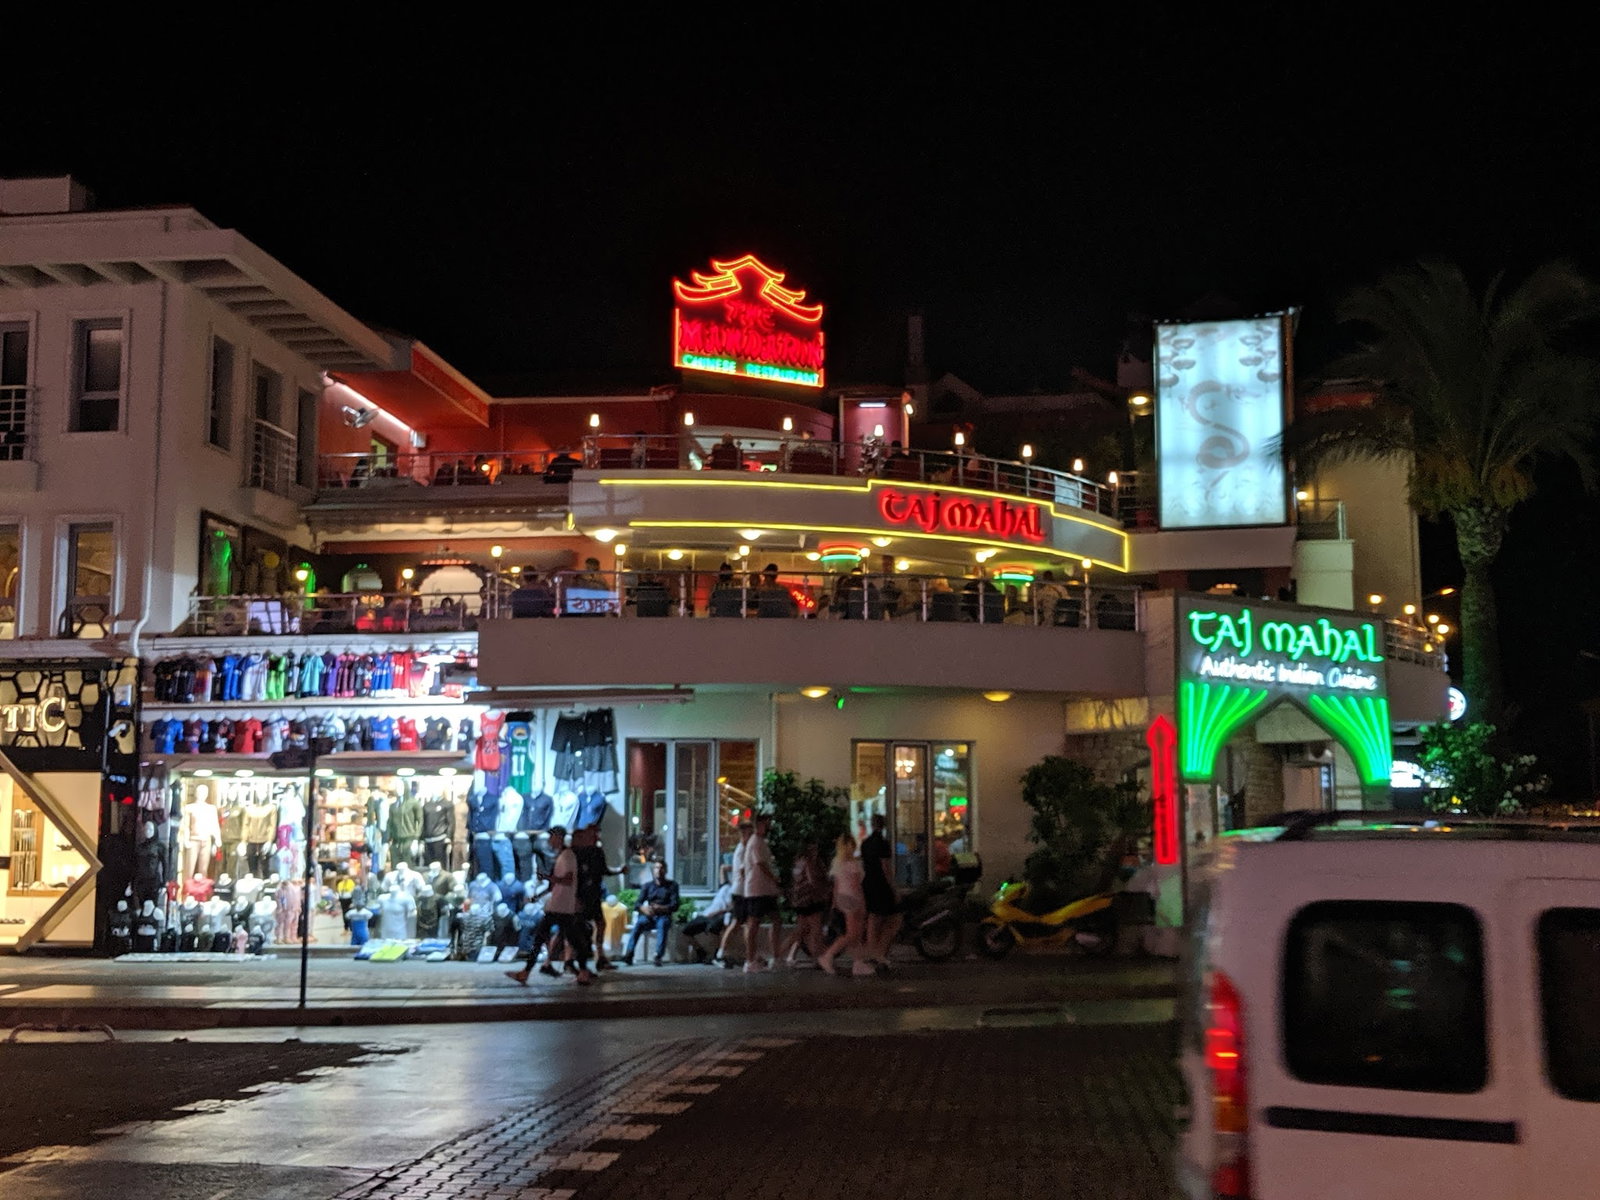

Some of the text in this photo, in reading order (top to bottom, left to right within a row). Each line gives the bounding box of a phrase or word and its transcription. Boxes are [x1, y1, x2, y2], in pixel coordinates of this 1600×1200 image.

[723, 299, 775, 332] THE
[680, 320, 823, 368] MANDARIN
[682, 354, 820, 385] CHINESE RESTAURANT
[1200, 655, 1378, 690] Authentic Indian Cuisine
[511, 753, 526, 777] 11
